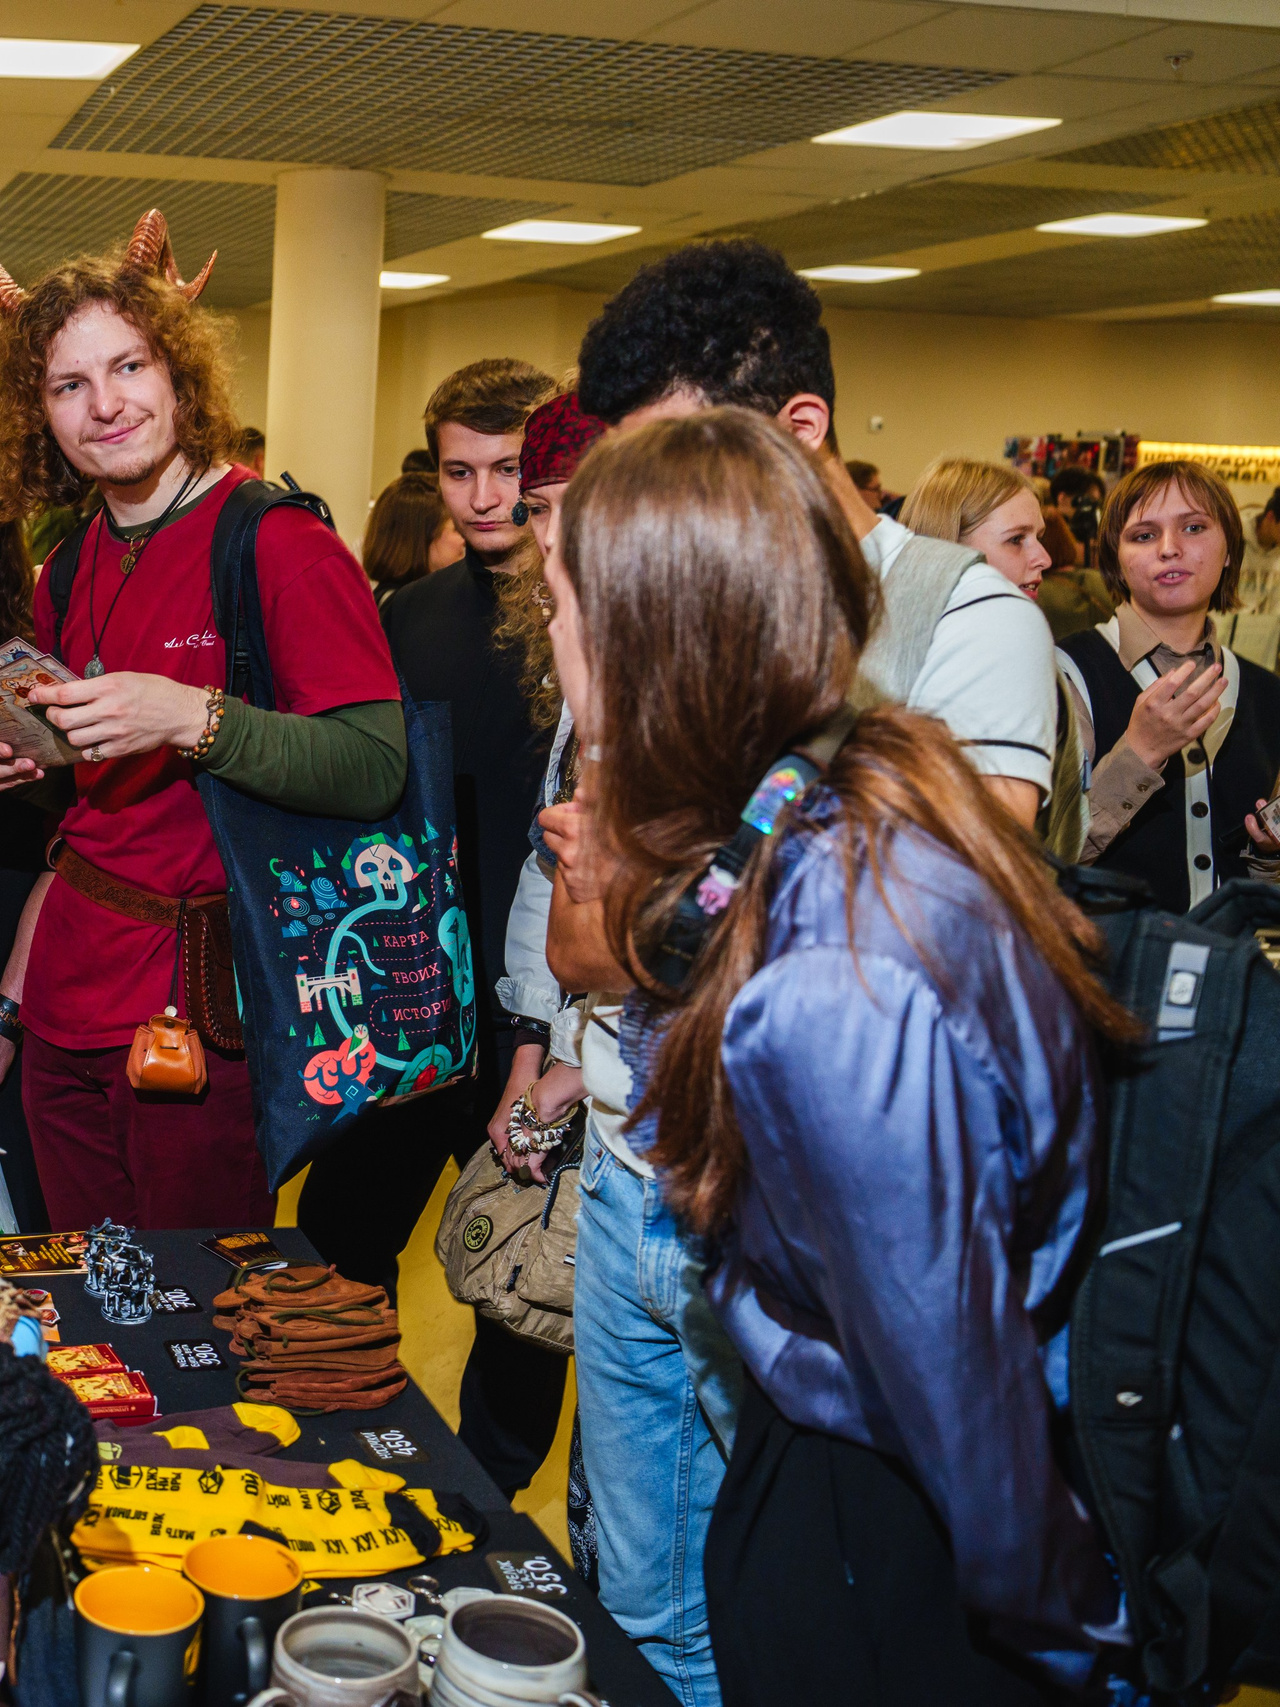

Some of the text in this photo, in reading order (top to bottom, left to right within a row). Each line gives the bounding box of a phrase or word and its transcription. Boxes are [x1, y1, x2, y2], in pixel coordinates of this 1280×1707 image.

[383, 930, 430, 948] КАРТА
[392, 962, 442, 985] ТВОИХ
[392, 994, 452, 1022] ИСТОРИ
[150, 1512, 165, 1536] ВОЛК
[165, 1527, 196, 1541] МАТЬ
